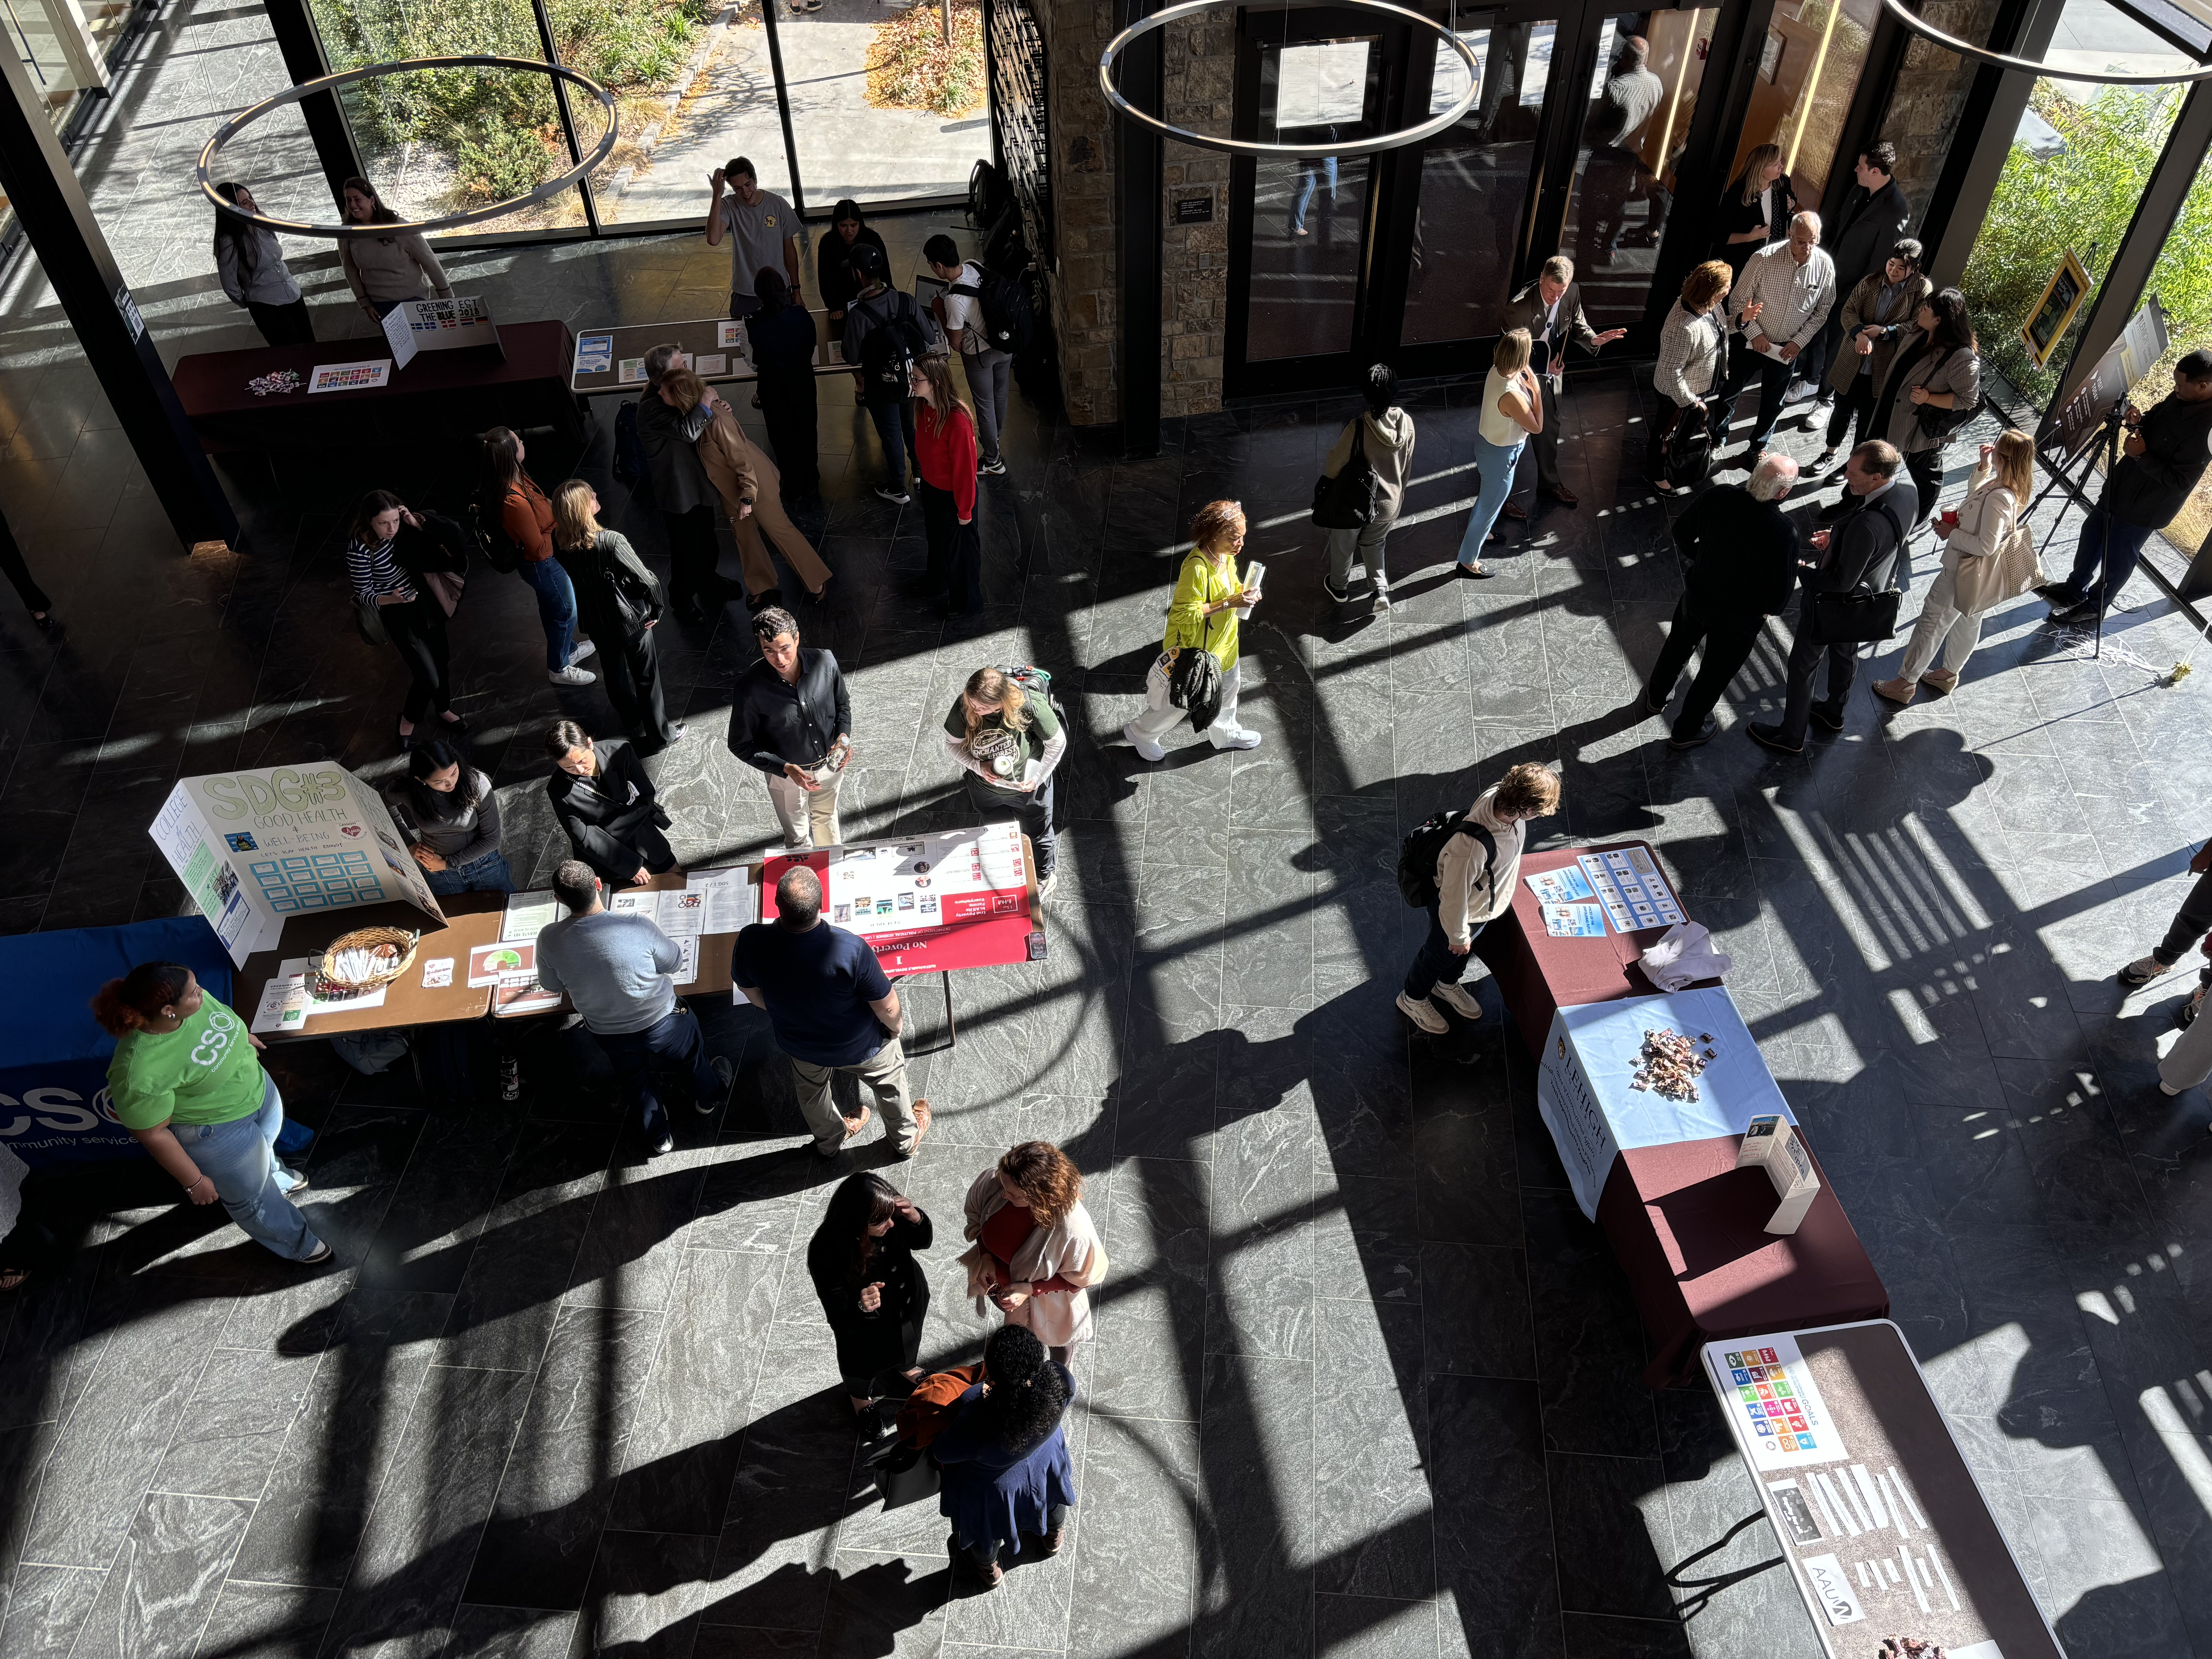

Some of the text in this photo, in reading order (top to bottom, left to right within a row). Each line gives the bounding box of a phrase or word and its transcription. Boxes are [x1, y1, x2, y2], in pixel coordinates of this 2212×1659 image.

[416, 300, 479, 313] GREENING EST.
[419, 307, 479, 322] THE BLUE 2018
[2139, 319, 2149, 345] LEHIGH
[973, 739, 1012, 755] ENCHANTED
[203, 768, 345, 820] SDG#3
[156, 788, 188, 840] COLLEGE
[254, 808, 348, 829] GOOD HEALTH
[172, 821, 200, 867] HEALTH
[264, 831, 330, 847] WELL-BEING
[871, 940, 927, 954] No Poverty
[895, 955, 903, 965] 1
[191, 1012, 235, 1065] CSO
[211, 1047, 231, 1072] community
[229, 1031, 239, 1048] service
[1541, 1061, 1554, 1076] ehigh
[1555, 1066, 1563, 1086] Office
[1566, 1089, 1585, 1135] International
[1583, 1136, 1595, 1158] Affairs
[1565, 1067, 1602, 1154] UNIVERSITY
[1566, 1054, 1607, 1151] LEHIGH
[7, 1136, 139, 1149] mmunity service
[1795, 1156, 1804, 1175] ipra
[1802, 1400, 1818, 1425] GOALS
[1795, 1525, 1803, 1534] all
